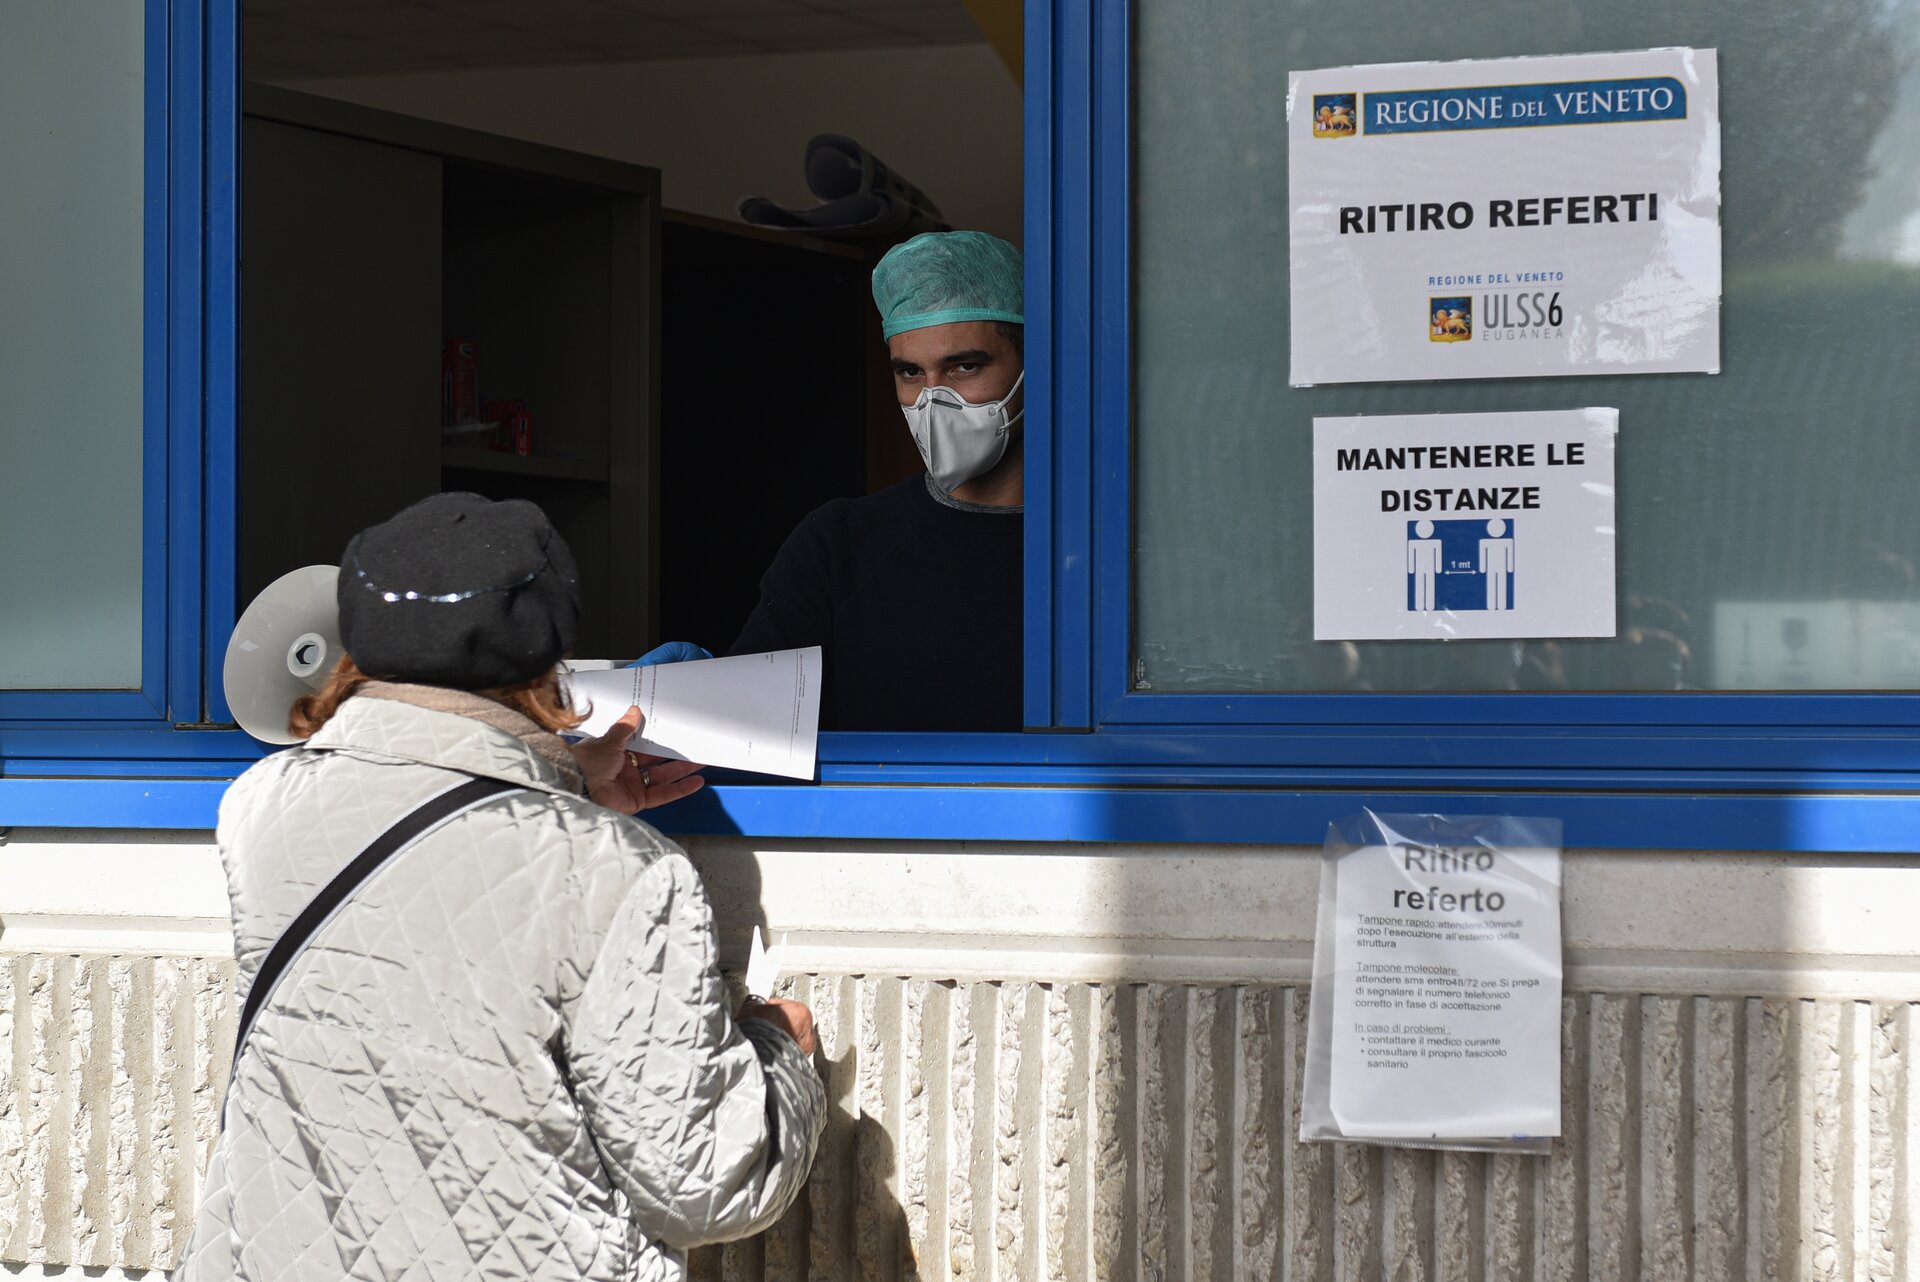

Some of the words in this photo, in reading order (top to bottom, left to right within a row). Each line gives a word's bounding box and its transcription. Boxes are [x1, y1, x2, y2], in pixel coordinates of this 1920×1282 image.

[1375, 97, 1504, 126] REGIONE
[1511, 101, 1547, 118] DEL
[1553, 86, 1674, 116] VENETO
[1339, 201, 1474, 235] RITIRO
[1489, 193, 1658, 228] REFERTI
[1428, 274, 1482, 286] REGIONE
[1488, 273, 1510, 284] DEL
[1516, 271, 1564, 282] VENETO
[1483, 291, 1563, 329] ULSS6
[1483, 329, 1564, 341] EUGANEA
[1337, 443, 1535, 471] MANTENERE
[1547, 442, 1585, 466] LE
[1381, 486, 1541, 512] DISTANZE
[1458, 560, 1471, 569] mt
[1405, 846, 1494, 873] Ritiro
[1394, 886, 1505, 912] referto
[1358, 914, 1403, 927] Tampone
[1357, 927, 1381, 937] dopo
[1384, 927, 1443, 940] l'esecuzione
[1497, 931, 1520, 941] della
[1357, 939, 1397, 949] struttura
[1356, 962, 1402, 974] Tampone
[1356, 975, 1402, 985] attendere
[1405, 977, 1424, 986] sms
[1512, 978, 1540, 989] prega
[1355, 986, 1364, 996] di
[1367, 987, 1415, 998] segnalare
[1425, 989, 1462, 998] numero
[1464, 990, 1511, 1000] telefonico
[1355, 1000, 1393, 1009] corretto
[1394, 1000, 1404, 1009] in
[1406, 1000, 1427, 1010] fase
[1429, 1000, 1439, 1010] di
[1354, 1022, 1364, 1032] In
[1366, 1024, 1390, 1033] caso
[1392, 1023, 1401, 1033] di
[1367, 1035, 1417, 1045] contattare
[1427, 1036, 1462, 1046] medico
[1464, 1037, 1501, 1046] curante
[1367, 1048, 1418, 1057] consultare
[1428, 1049, 1463, 1060] proprio
[1465, 1048, 1508, 1058] fascicolo
[1367, 1059, 1409, 1069] sanitario
